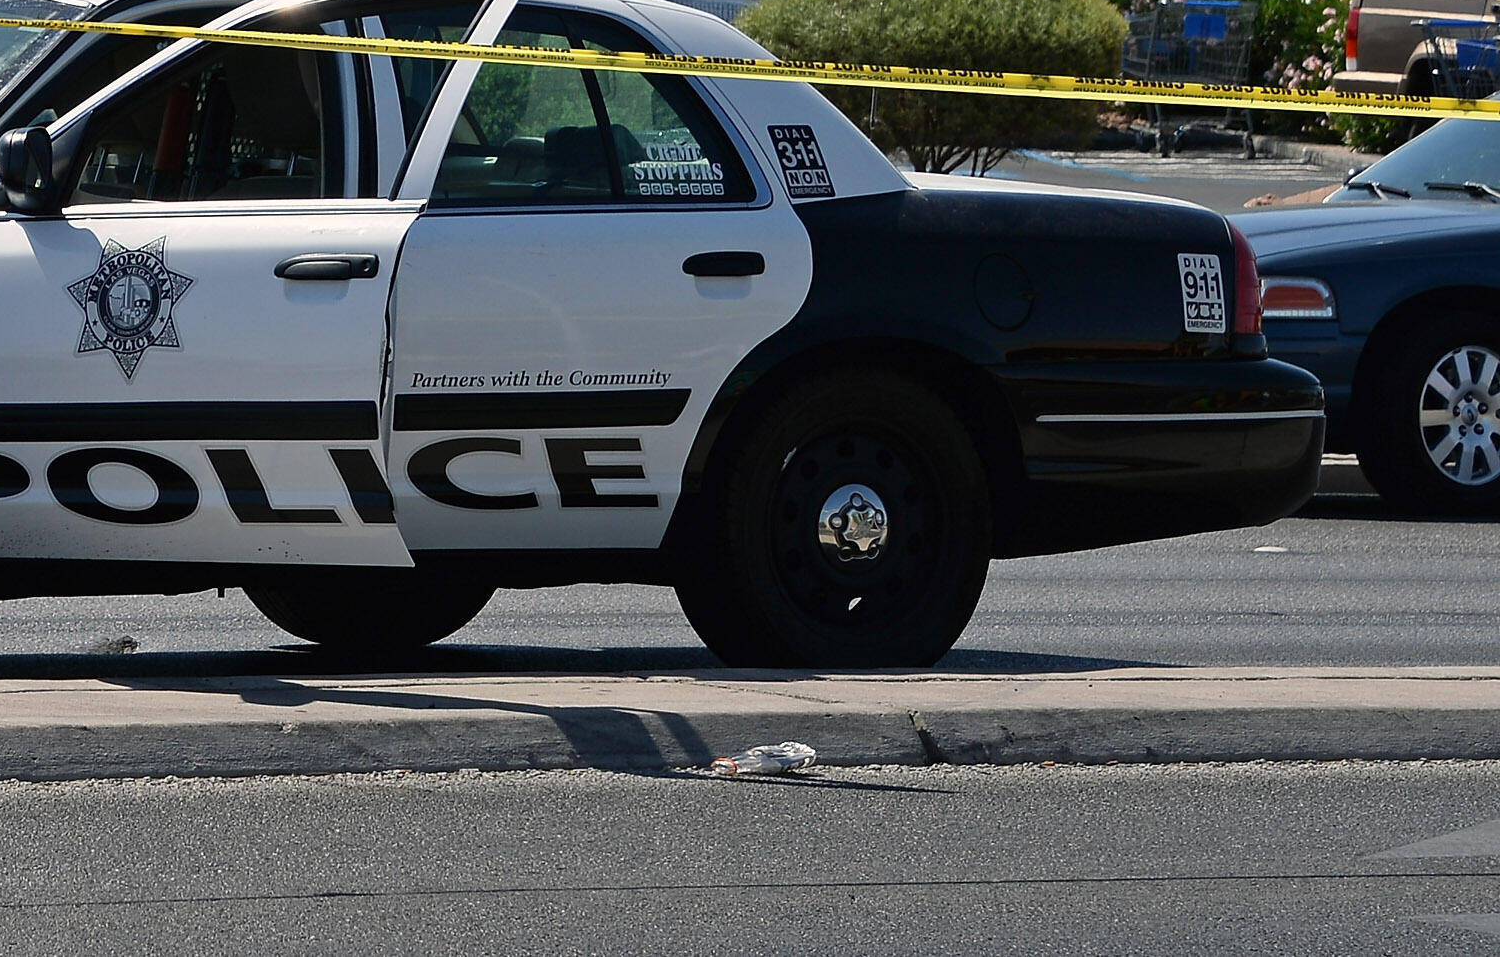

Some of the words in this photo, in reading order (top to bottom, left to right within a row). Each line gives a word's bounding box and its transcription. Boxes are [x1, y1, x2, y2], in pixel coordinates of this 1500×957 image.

[774, 129, 810, 139] DIAL
[646, 144, 702, 161] CRIME
[634, 163, 724, 181] STOPPERS
[788, 170, 828, 186] NON
[791, 186, 832, 195] EMERGENCY
[1183, 257, 1215, 269] DIAL
[88, 253, 171, 302] METROPOLITAN
[105, 270, 124, 289] LAS
[126, 267, 156, 287] VEGAS
[1187, 320, 1223, 330] EMERGENCY
[104, 332, 155, 351] POLICE
[411, 372, 485, 388] Partners
[491, 370, 530, 387] with
[536, 370, 563, 386] the
[569, 368, 671, 388] Community
